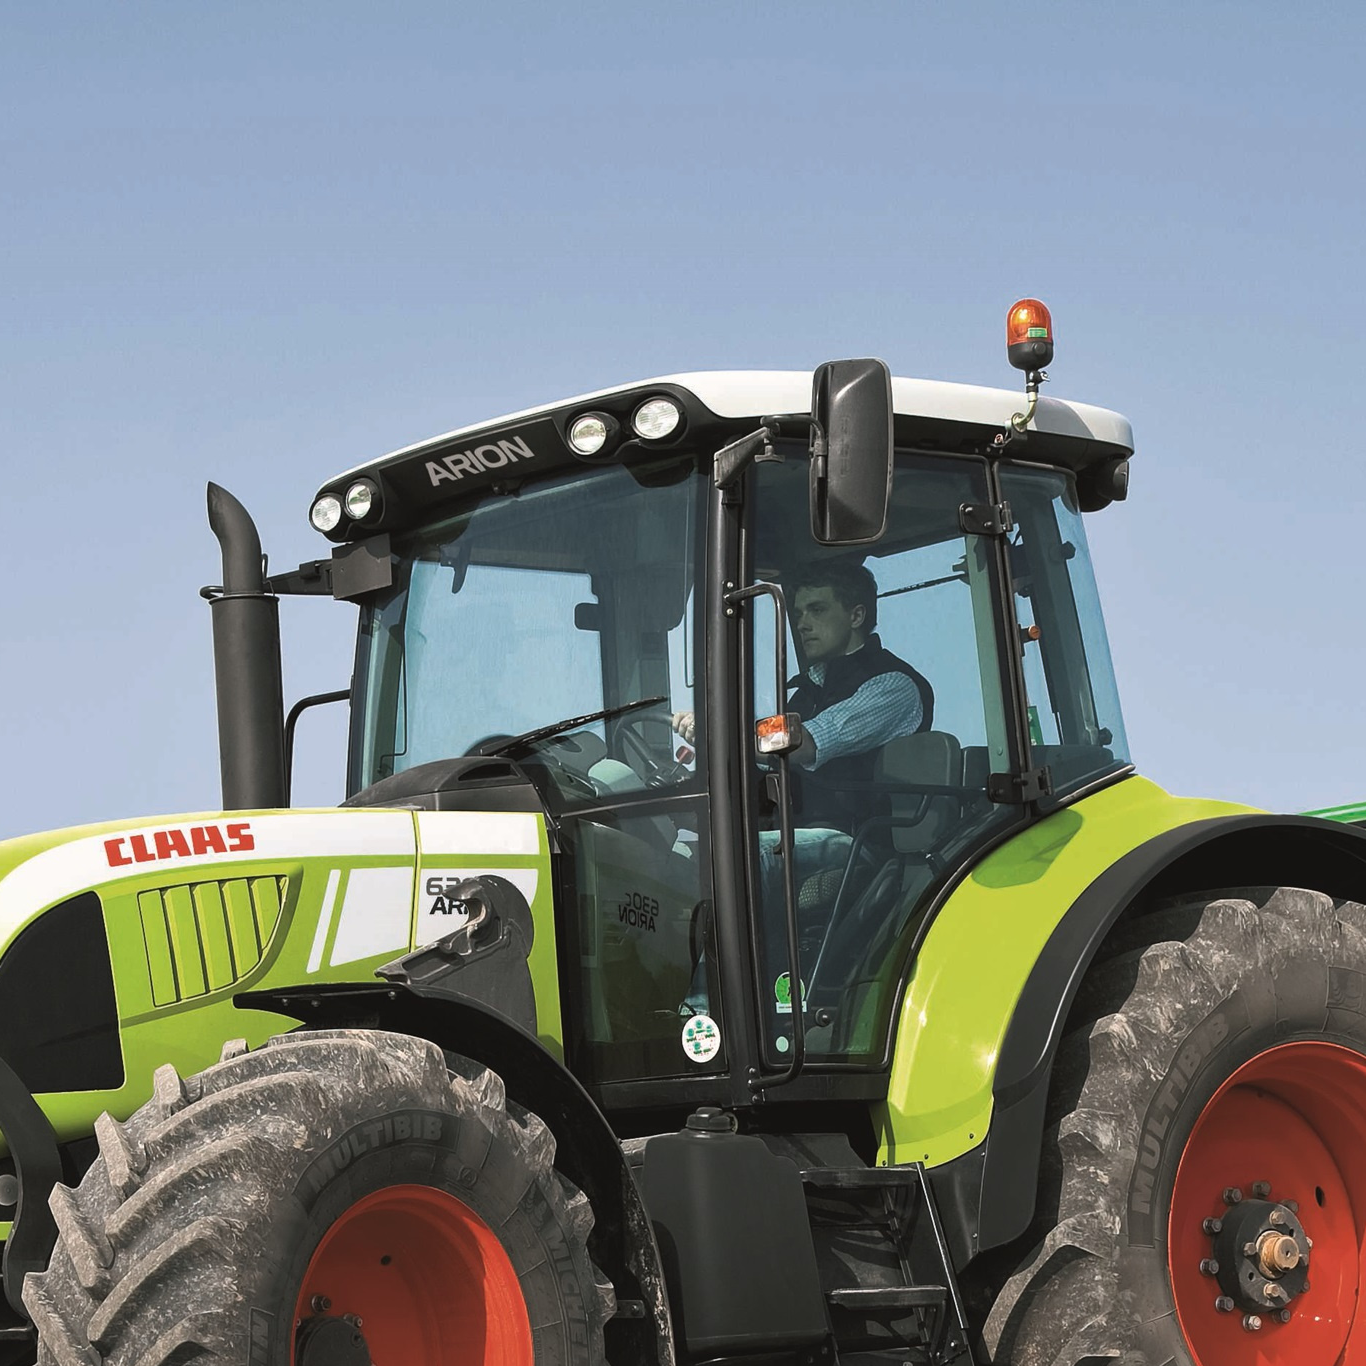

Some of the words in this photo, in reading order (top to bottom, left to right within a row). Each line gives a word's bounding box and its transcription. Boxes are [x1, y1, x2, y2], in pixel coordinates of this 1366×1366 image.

[424, 435, 536, 487] ARION
[103, 823, 254, 867] CLAAS
[1131, 1012, 1230, 1215] MULTIBIB
[306, 1114, 443, 1195] MULTIBIB
